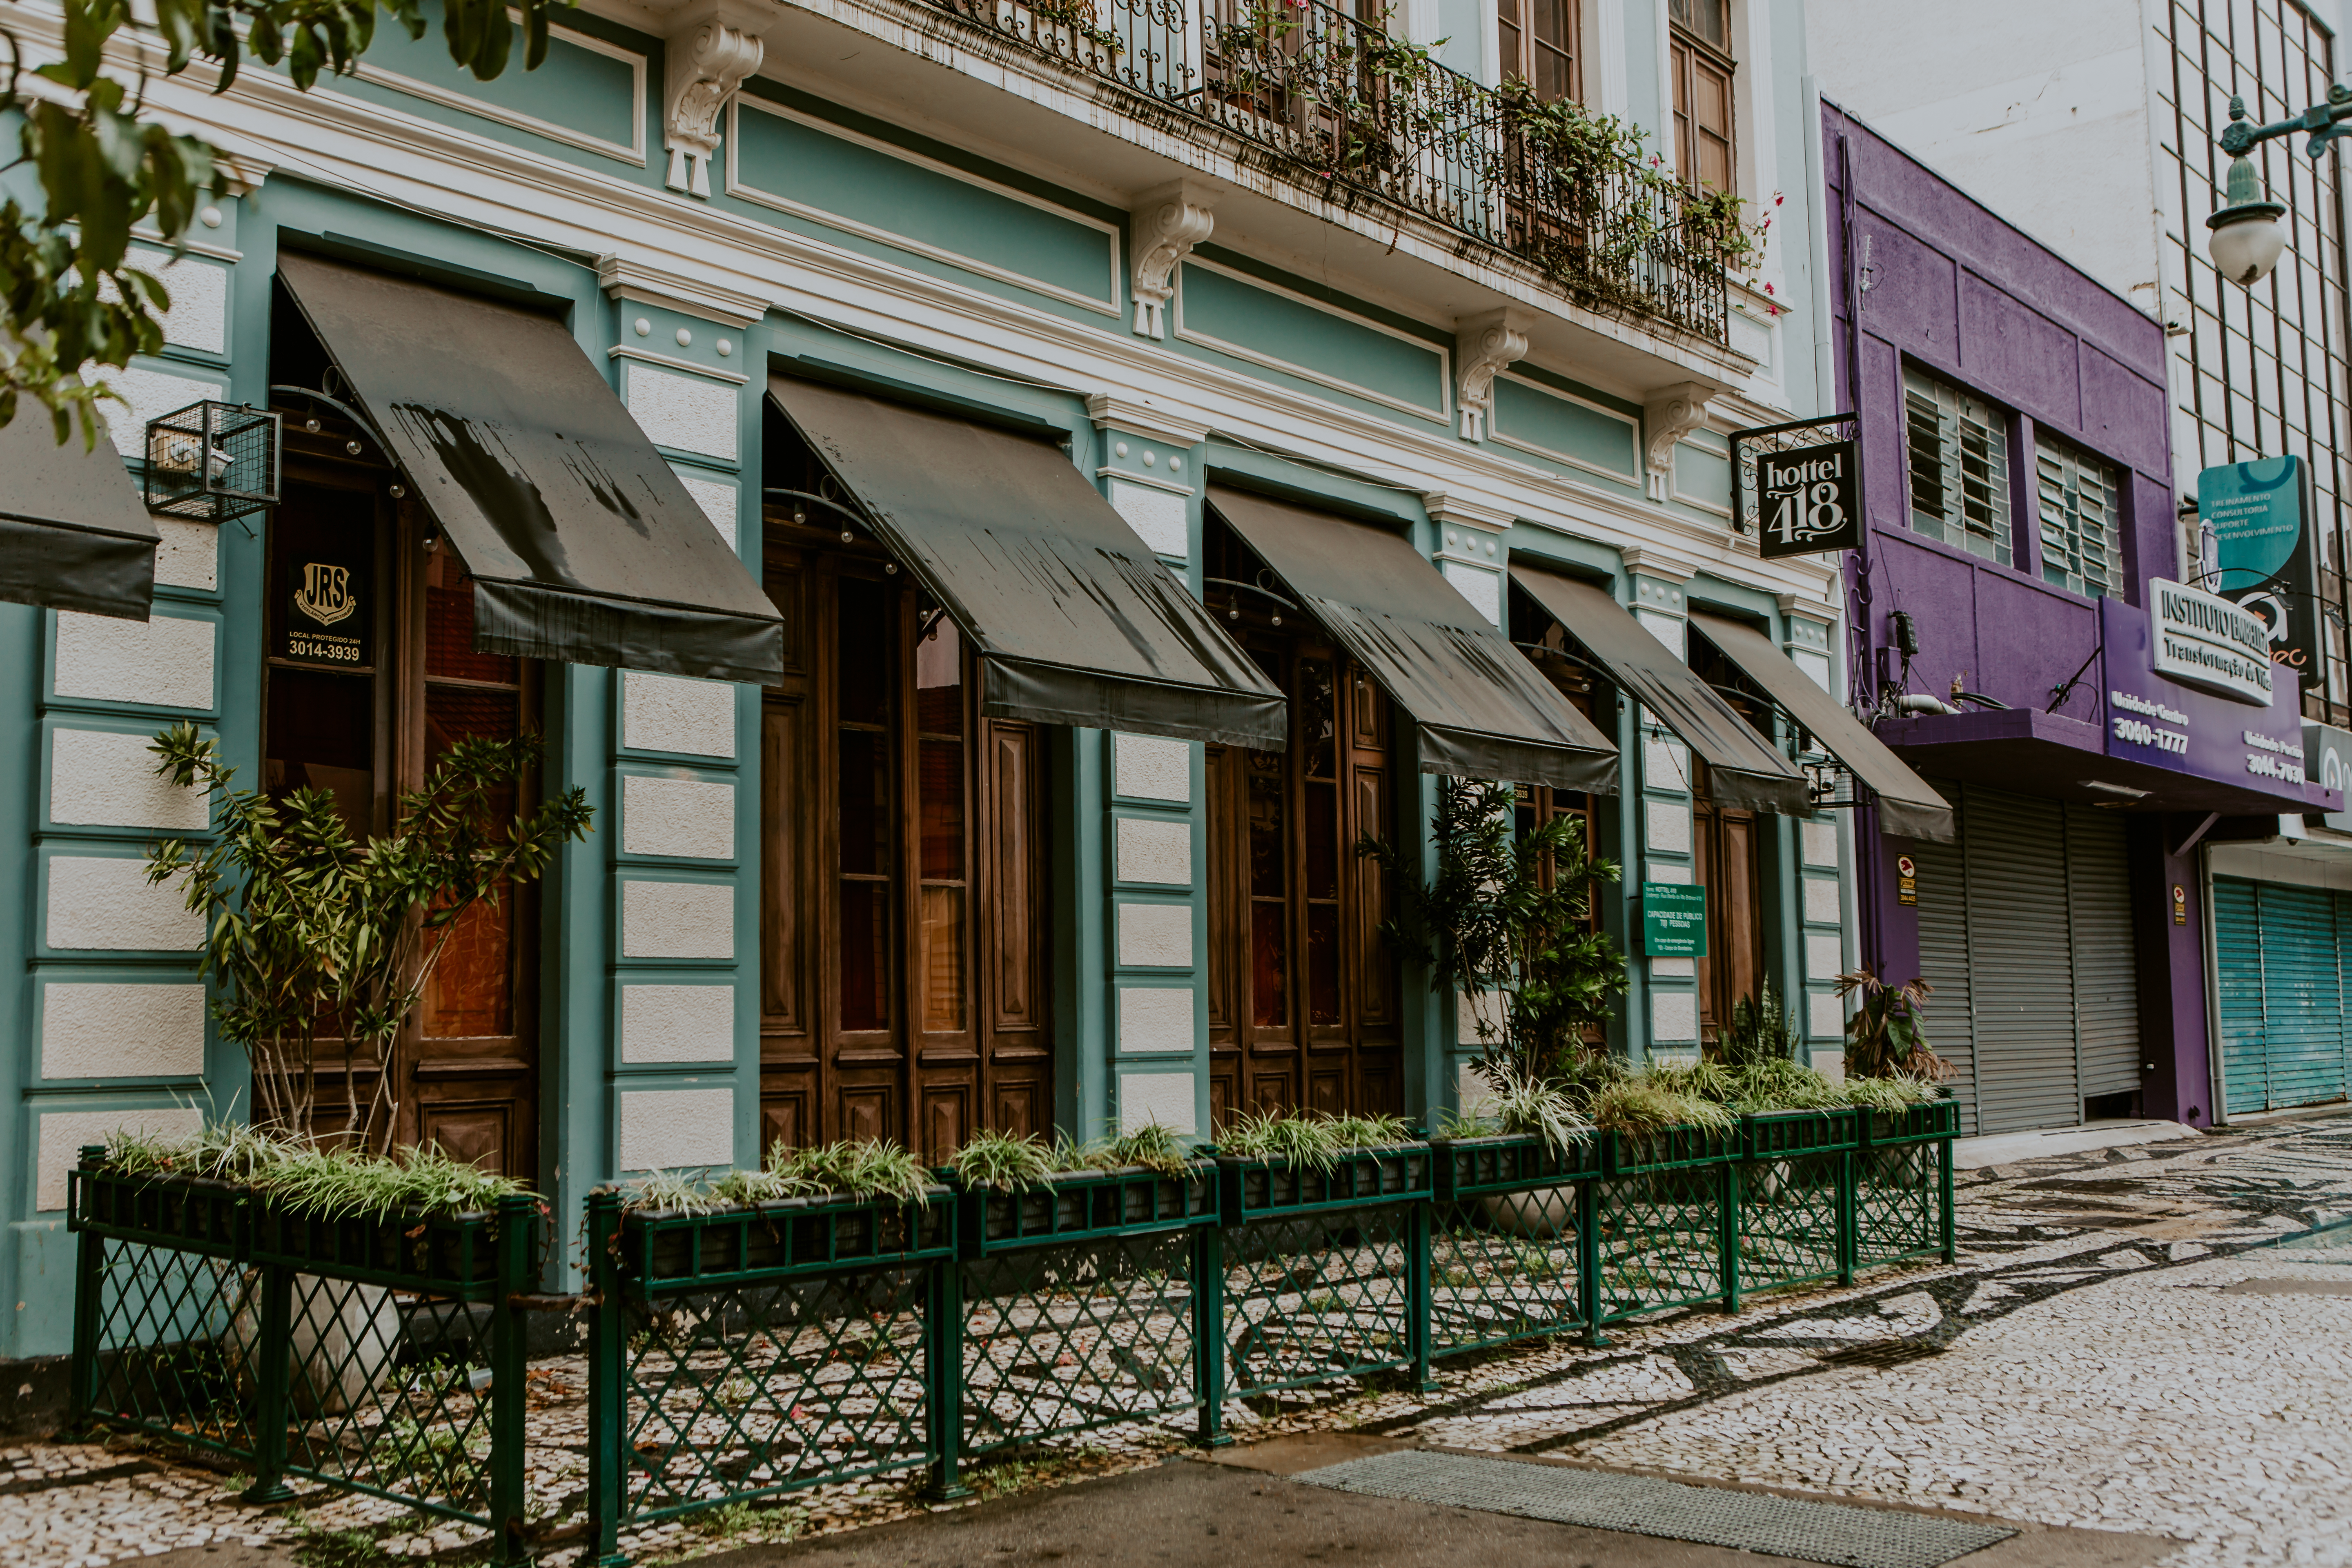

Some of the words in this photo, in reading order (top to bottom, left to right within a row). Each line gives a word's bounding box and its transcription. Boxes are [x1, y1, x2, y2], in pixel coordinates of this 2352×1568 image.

[1766, 453, 1842, 489] hottel
[1767, 482, 1844, 543] 418
[2211, 493, 2271, 508] TREINAMENTO
[2211, 505, 2268, 519] CONSULTORIA
[306, 565, 345, 609] JRS
[299, 602, 325, 622] VIGILÂNCIA
[327, 605, 353, 622] MONITORADA
[2162, 590, 2230, 636] INSTITUTO
[290, 640, 359, 661] 3014-3939
[312, 634, 348, 643] PROTEGIDO
[2164, 637, 2244, 677] Transformação
[2246, 662, 2256, 682] de
[2111, 690, 2157, 717] Unidade
[2157, 704, 2189, 726] Centro
[2113, 717, 2189, 755] 3040-1777
[2244, 730, 2279, 753] Unidade
[2279, 740, 2304, 760] Portão
[2246, 753, 2305, 785] 3044-7030
[1647, 910, 1676, 919] CAPACIDADE
[1683, 911, 1703, 920] PÚBLICO
[1669, 920, 1690, 928] PESSOAS
